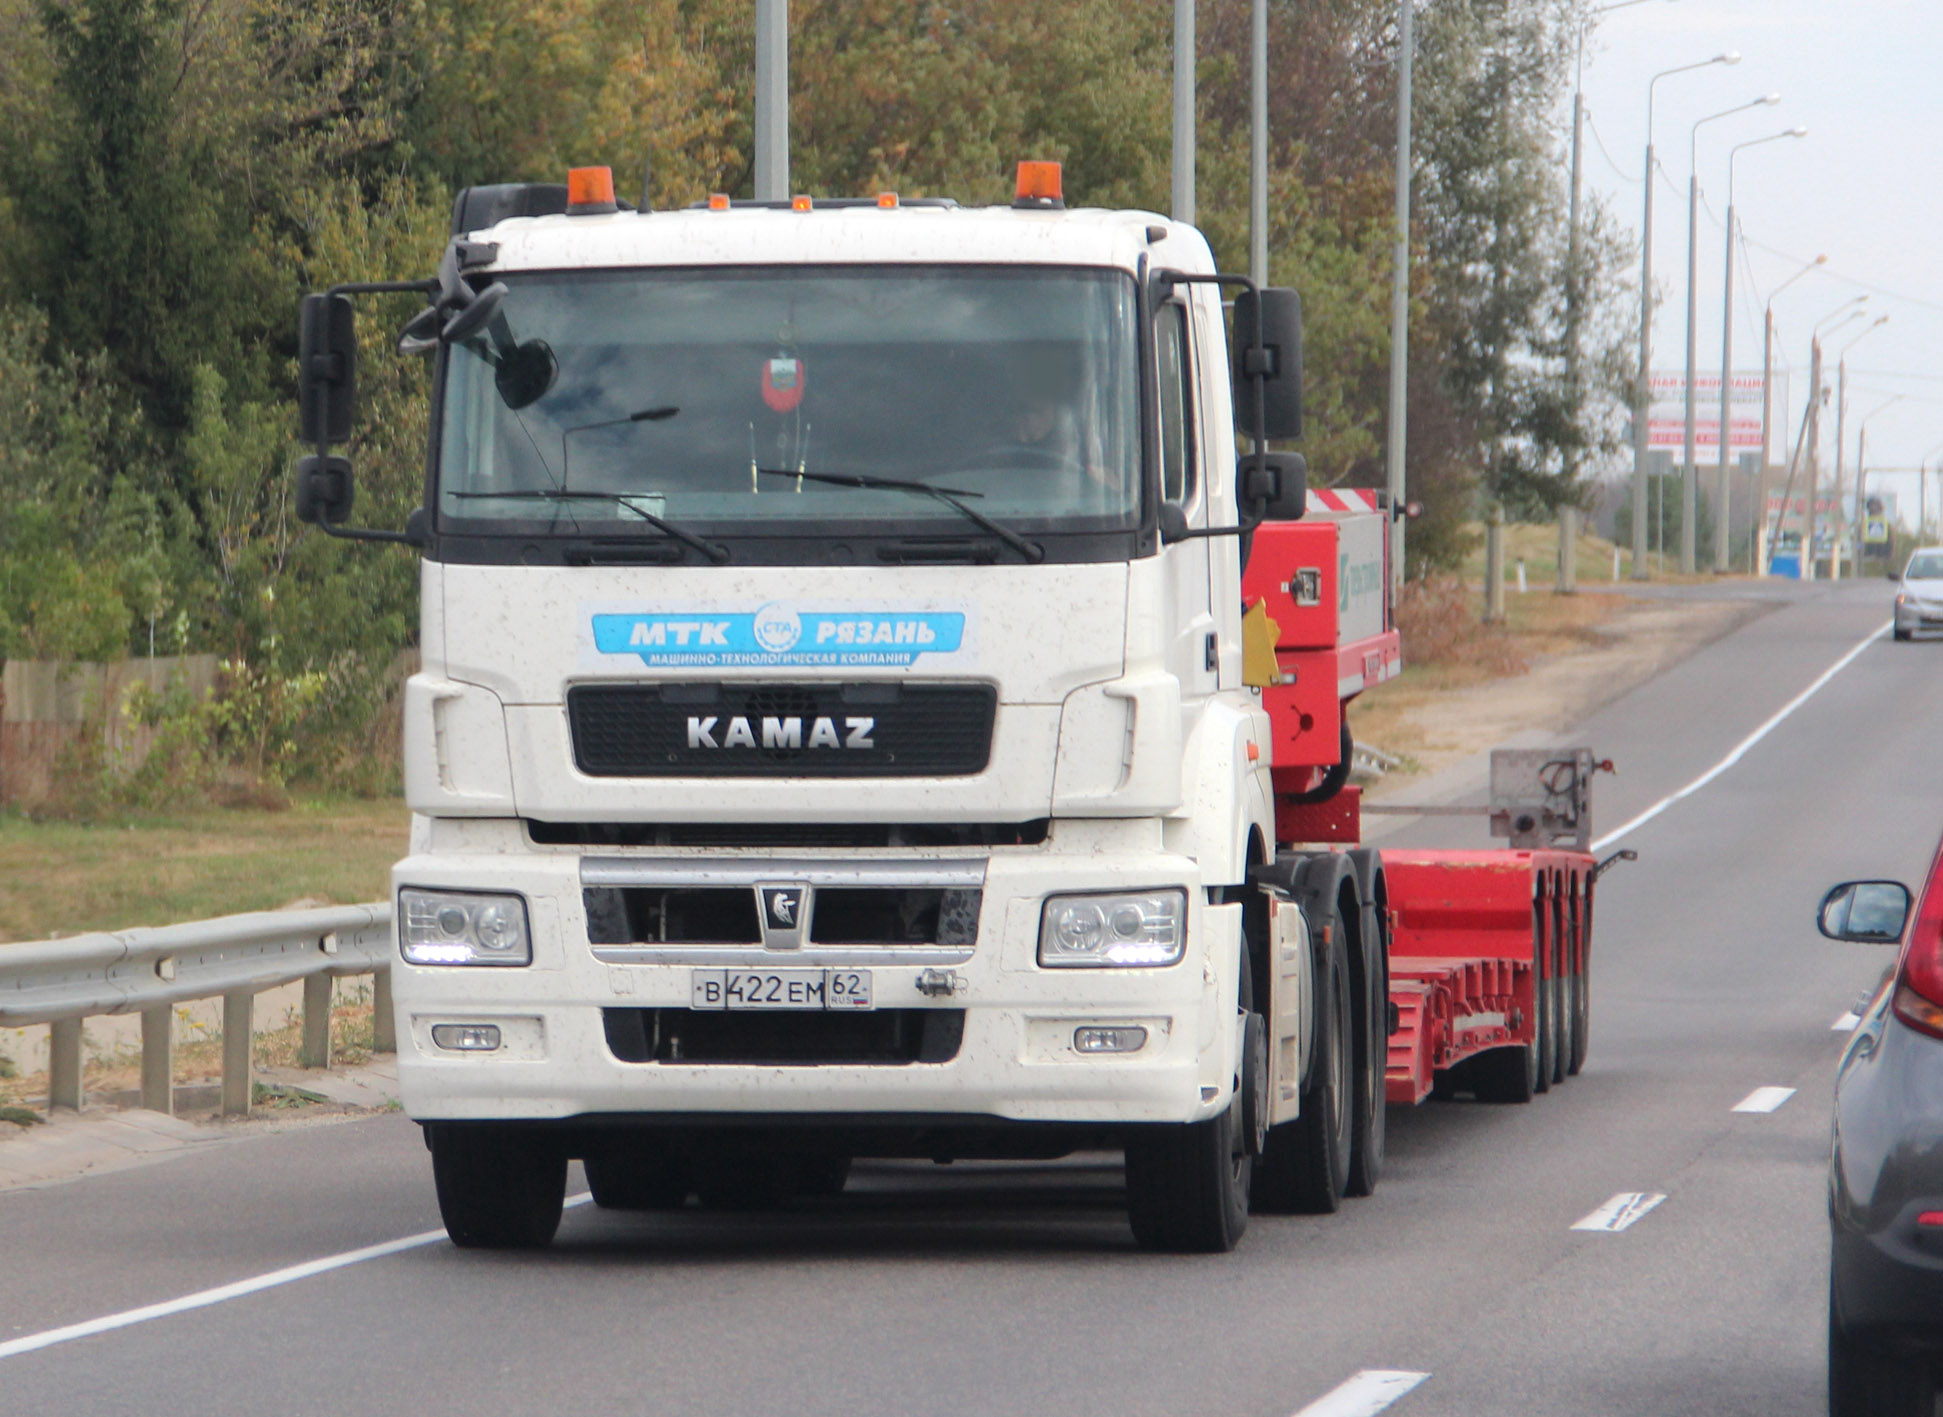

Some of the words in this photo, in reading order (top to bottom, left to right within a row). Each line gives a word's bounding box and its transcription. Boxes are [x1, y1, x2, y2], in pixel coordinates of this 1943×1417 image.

[630, 621, 731, 645] МТК
[816, 621, 936, 644] РЯЗАНЬ
[840, 652, 911, 665] КОМПАНИЯ
[687, 716, 875, 749] KAMAZ
